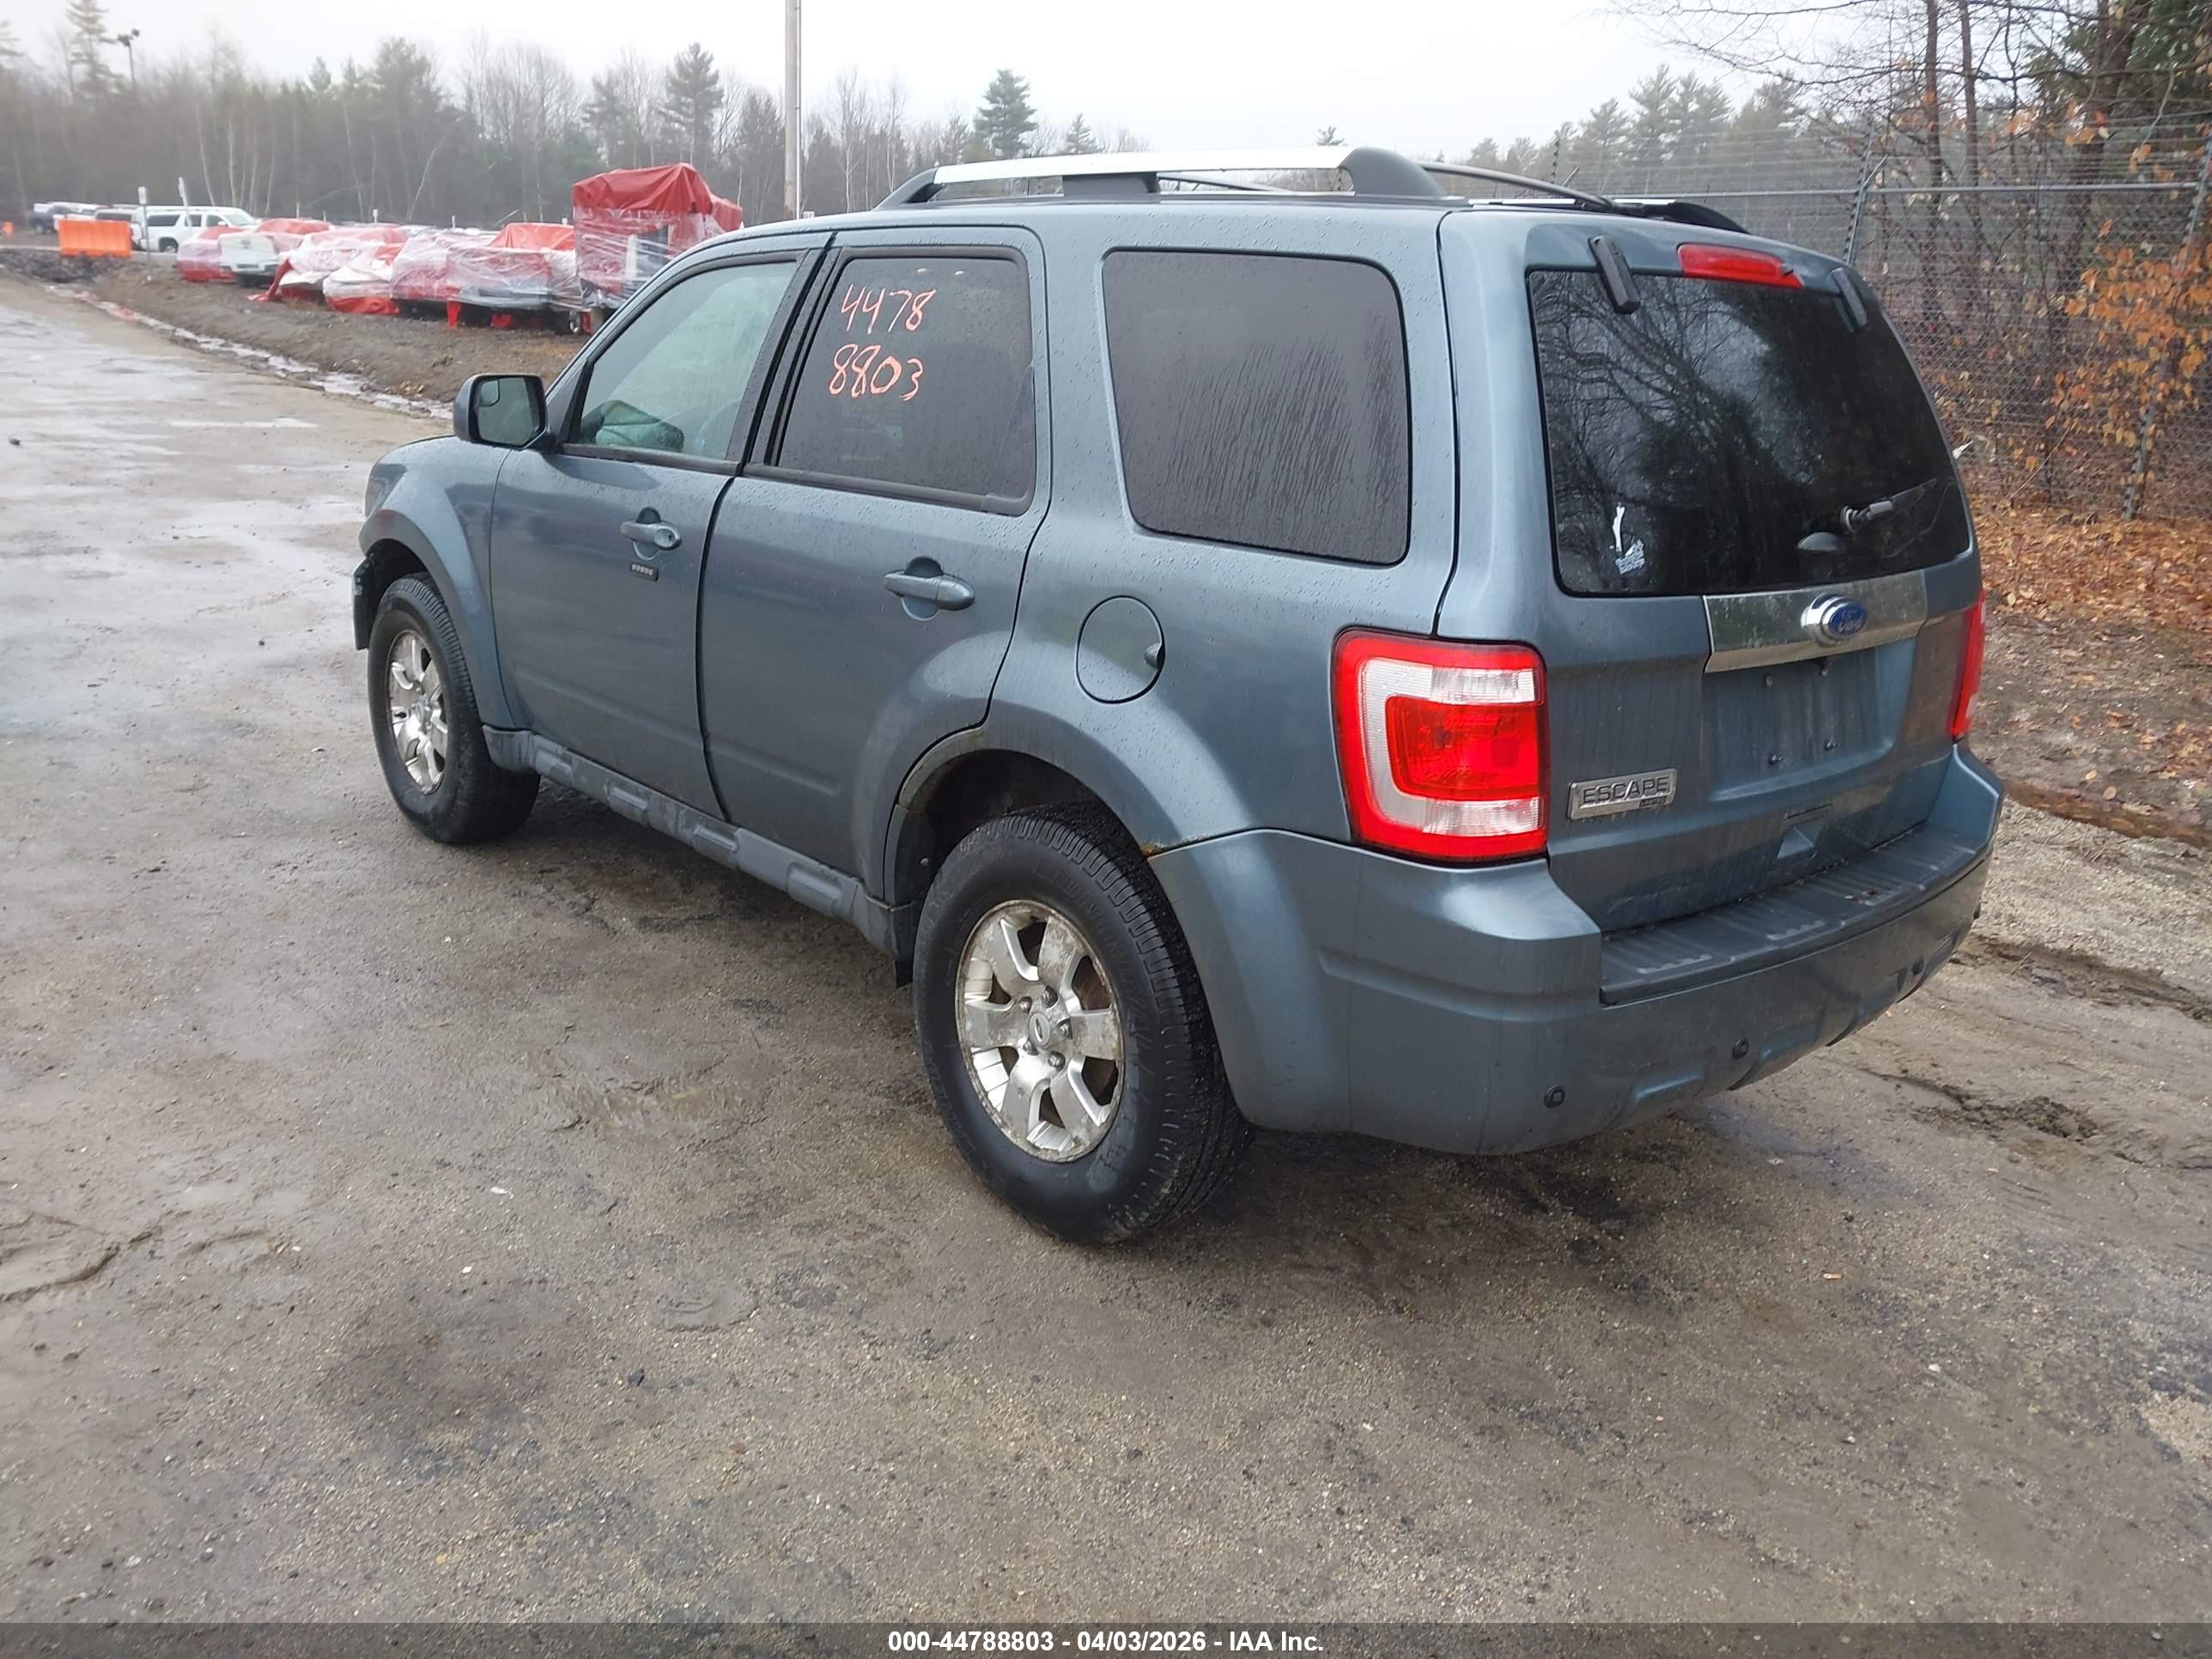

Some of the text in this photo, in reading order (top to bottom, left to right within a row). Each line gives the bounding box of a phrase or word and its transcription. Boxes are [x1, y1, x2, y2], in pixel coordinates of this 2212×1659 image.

[841, 283, 937, 335] 4478
[829, 343, 924, 401] 8803
[1583, 775, 1670, 804] ESCAPE
